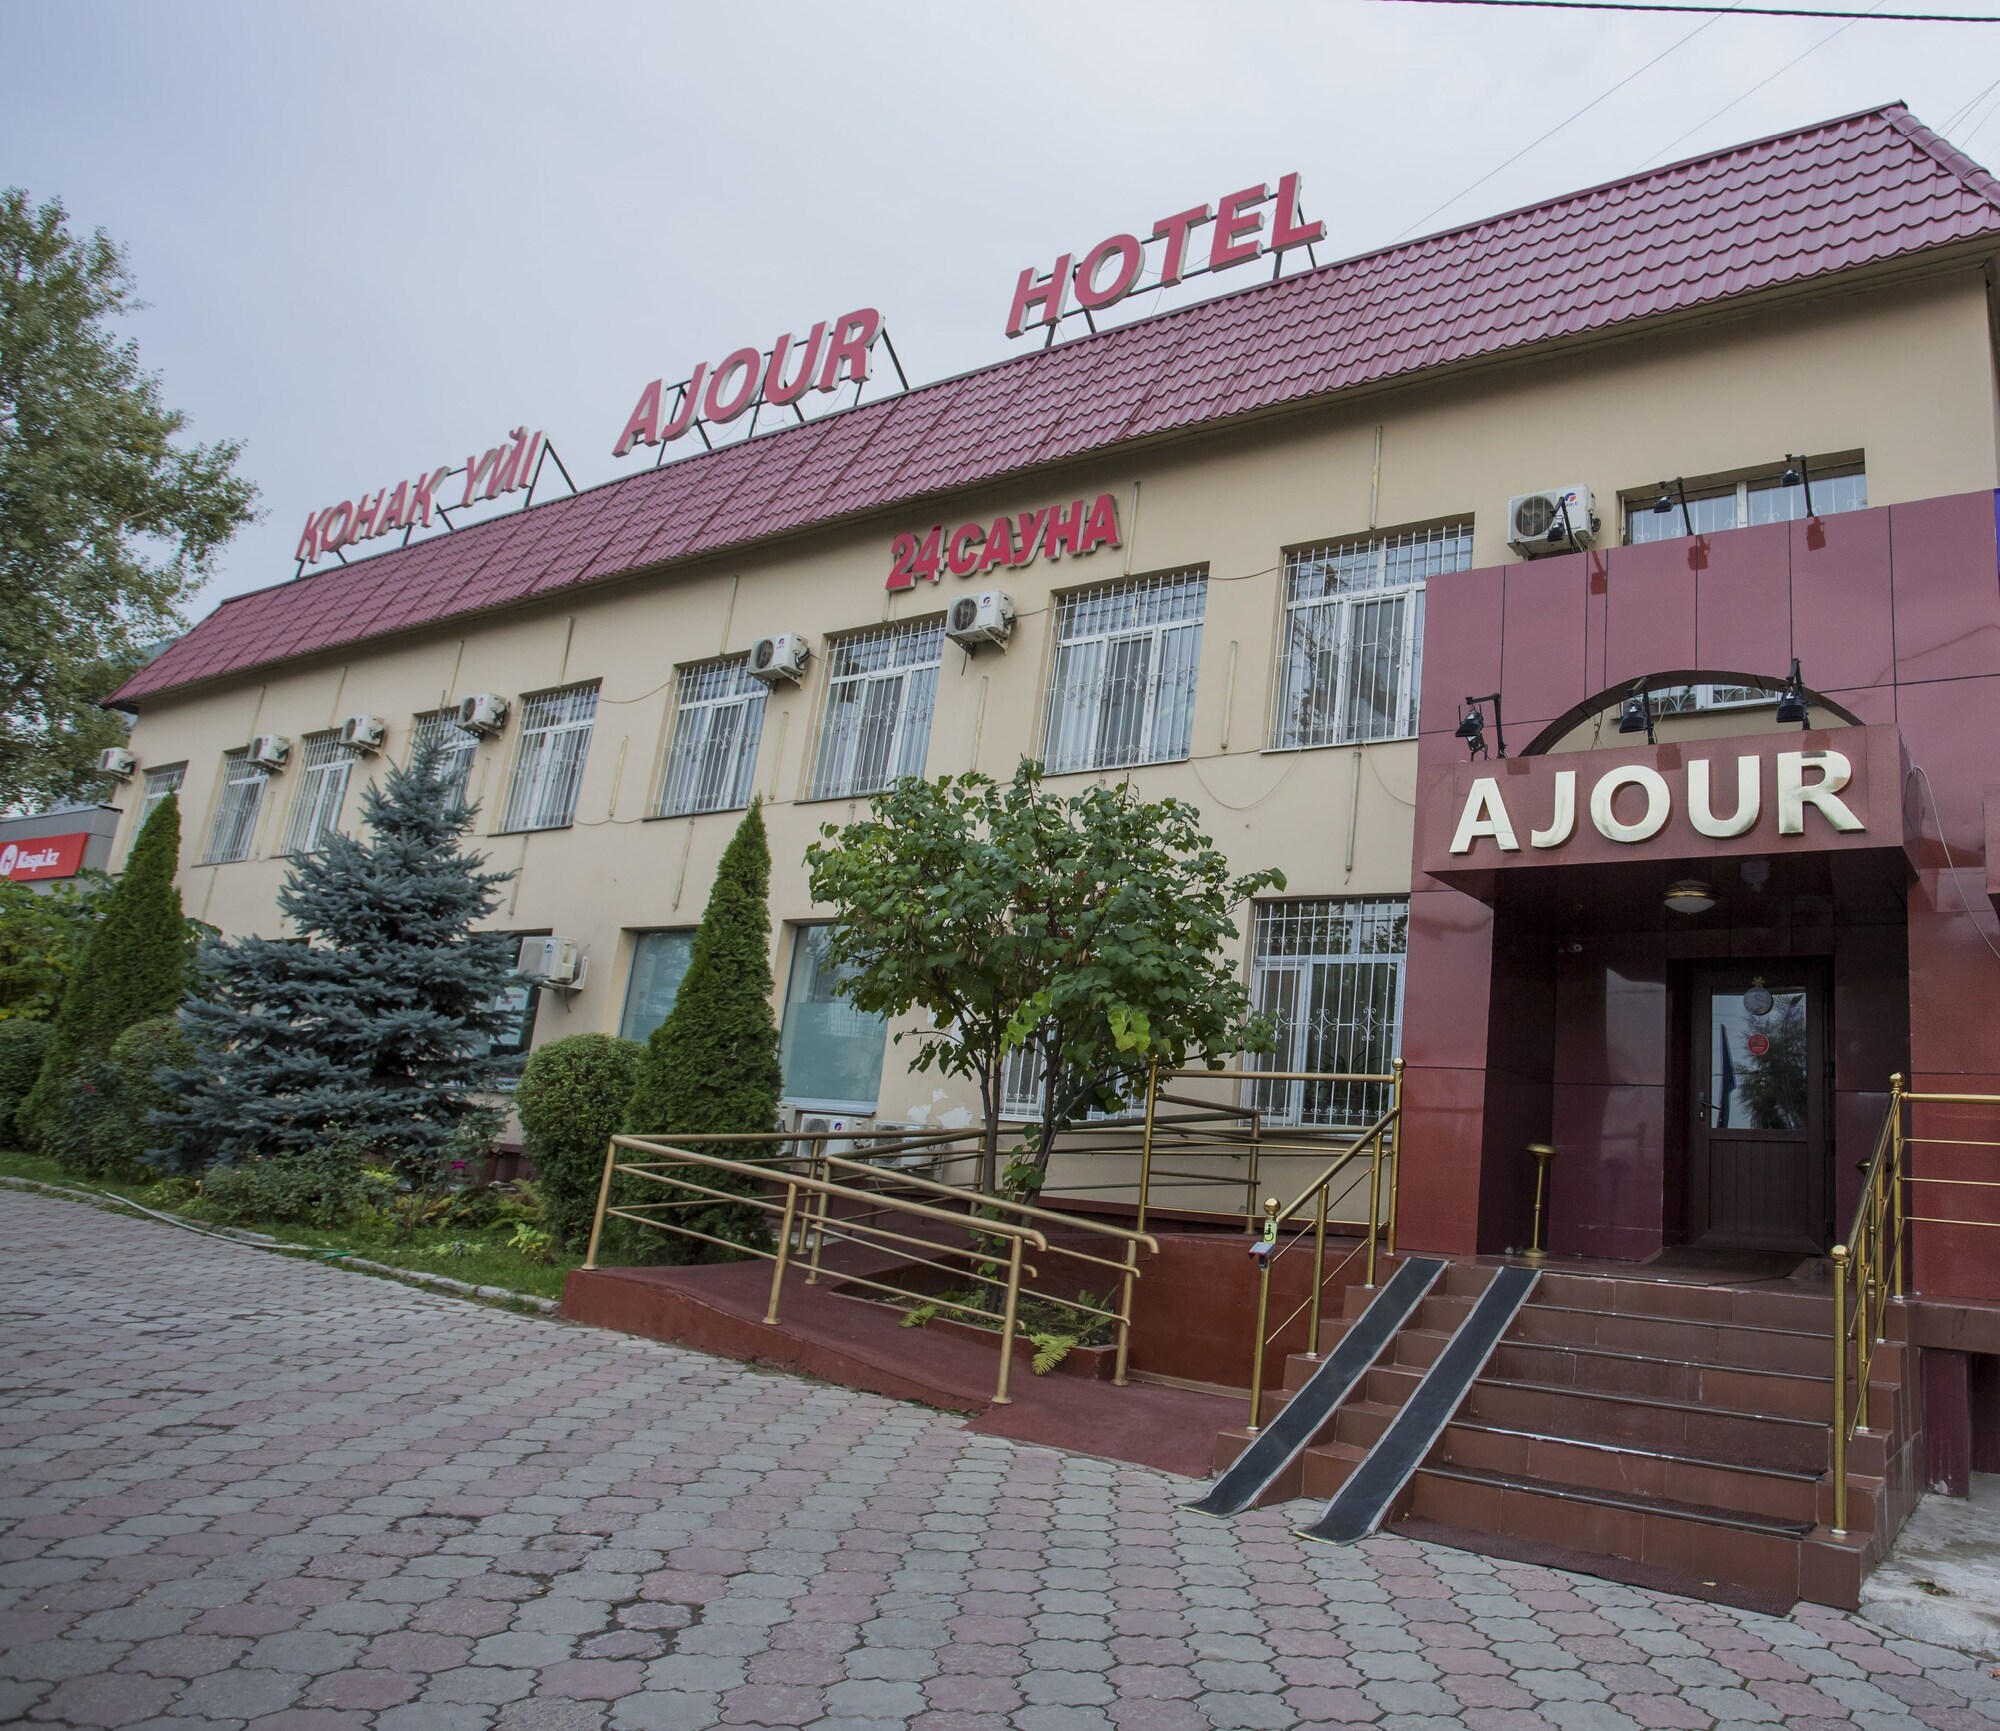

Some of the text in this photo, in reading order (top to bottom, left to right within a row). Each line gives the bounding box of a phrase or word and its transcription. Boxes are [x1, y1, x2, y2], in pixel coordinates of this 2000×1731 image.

[612, 171, 1326, 458] AJOUR HOTEL
[295, 465, 450, 564] КОНАК
[1449, 749, 1867, 855] AJOUR
